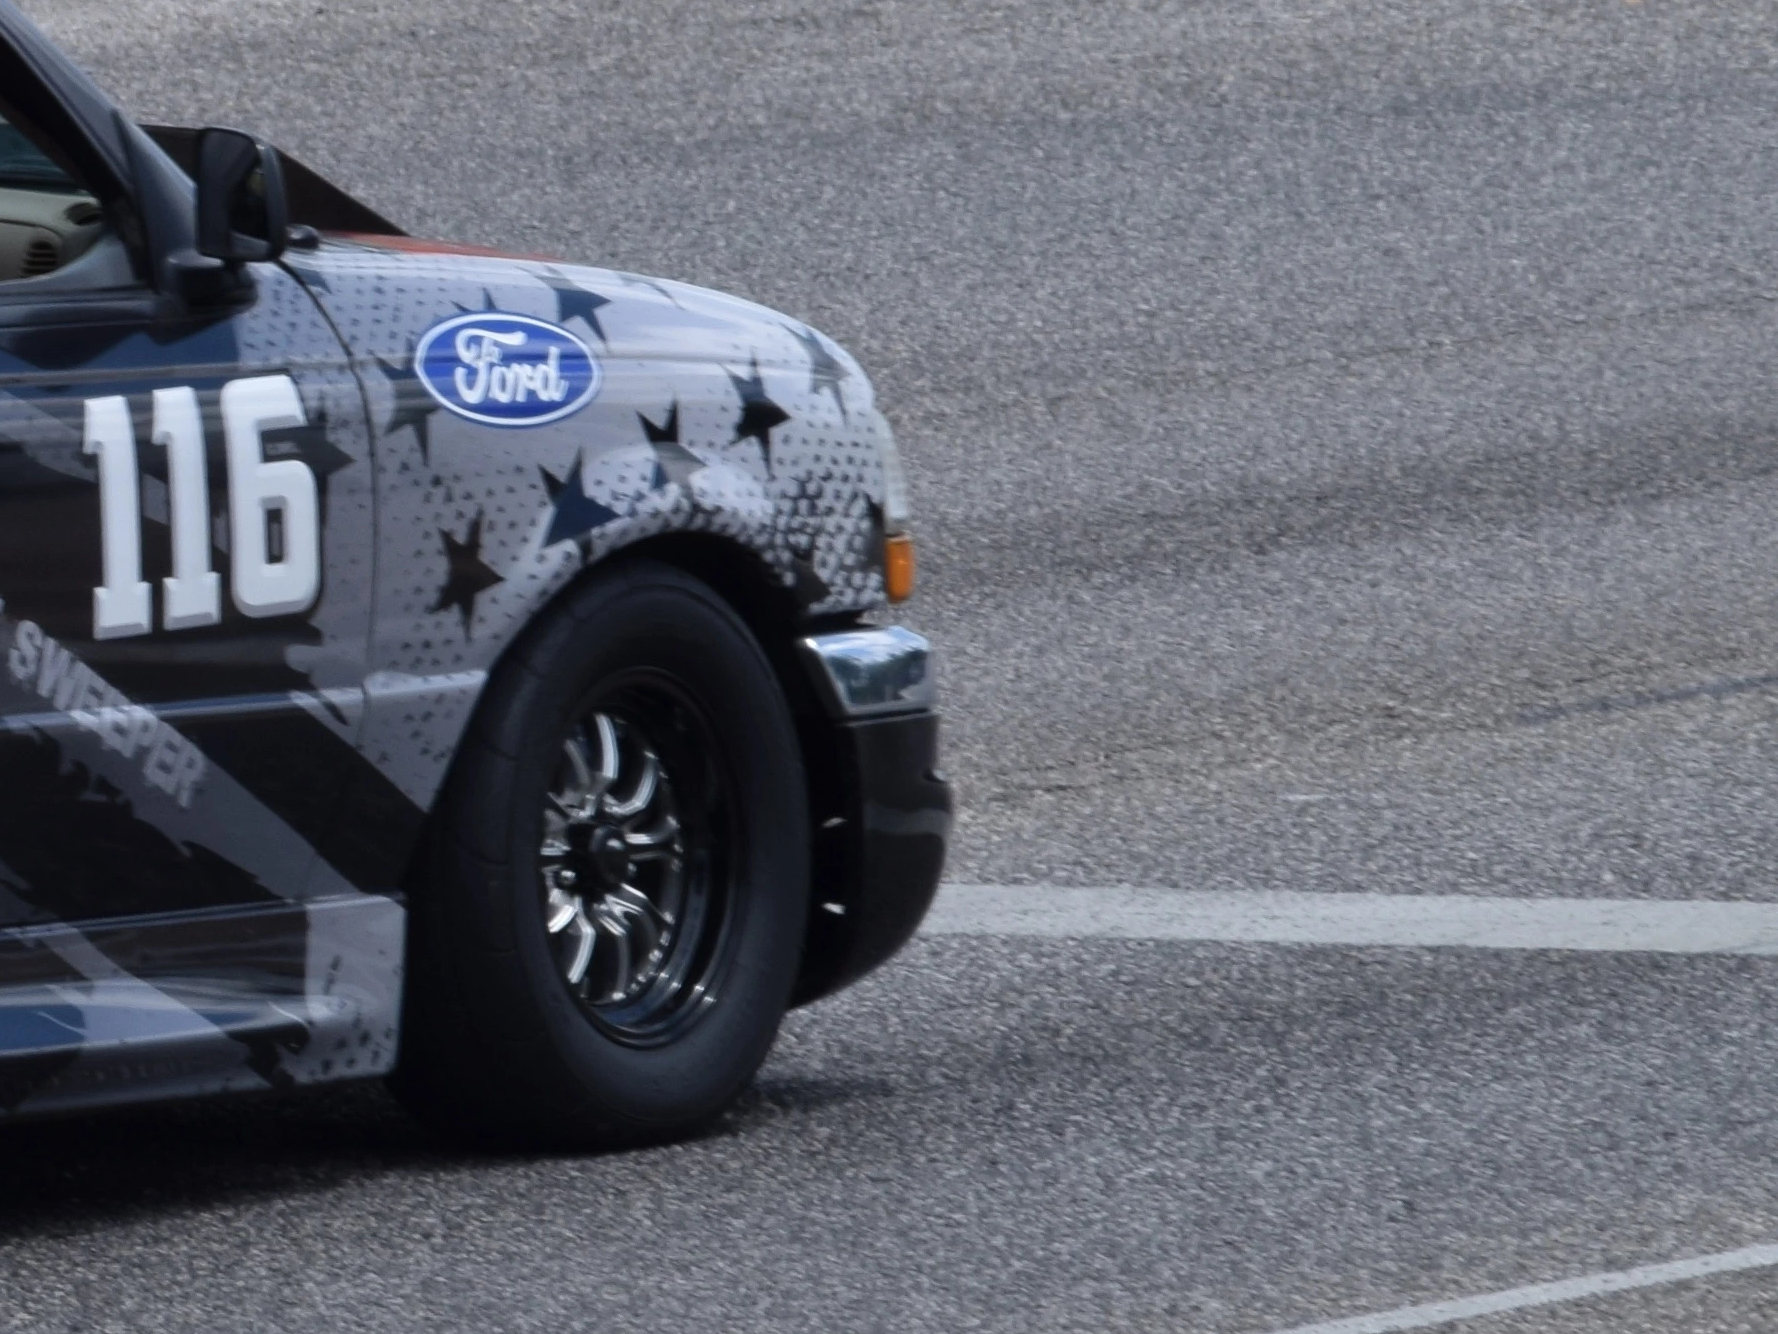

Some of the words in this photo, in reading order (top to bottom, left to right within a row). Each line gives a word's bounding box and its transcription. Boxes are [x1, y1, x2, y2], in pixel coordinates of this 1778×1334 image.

[453, 328, 569, 405] Ford
[82, 374, 321, 639] 116
[6, 617, 209, 809] SWEEPER
